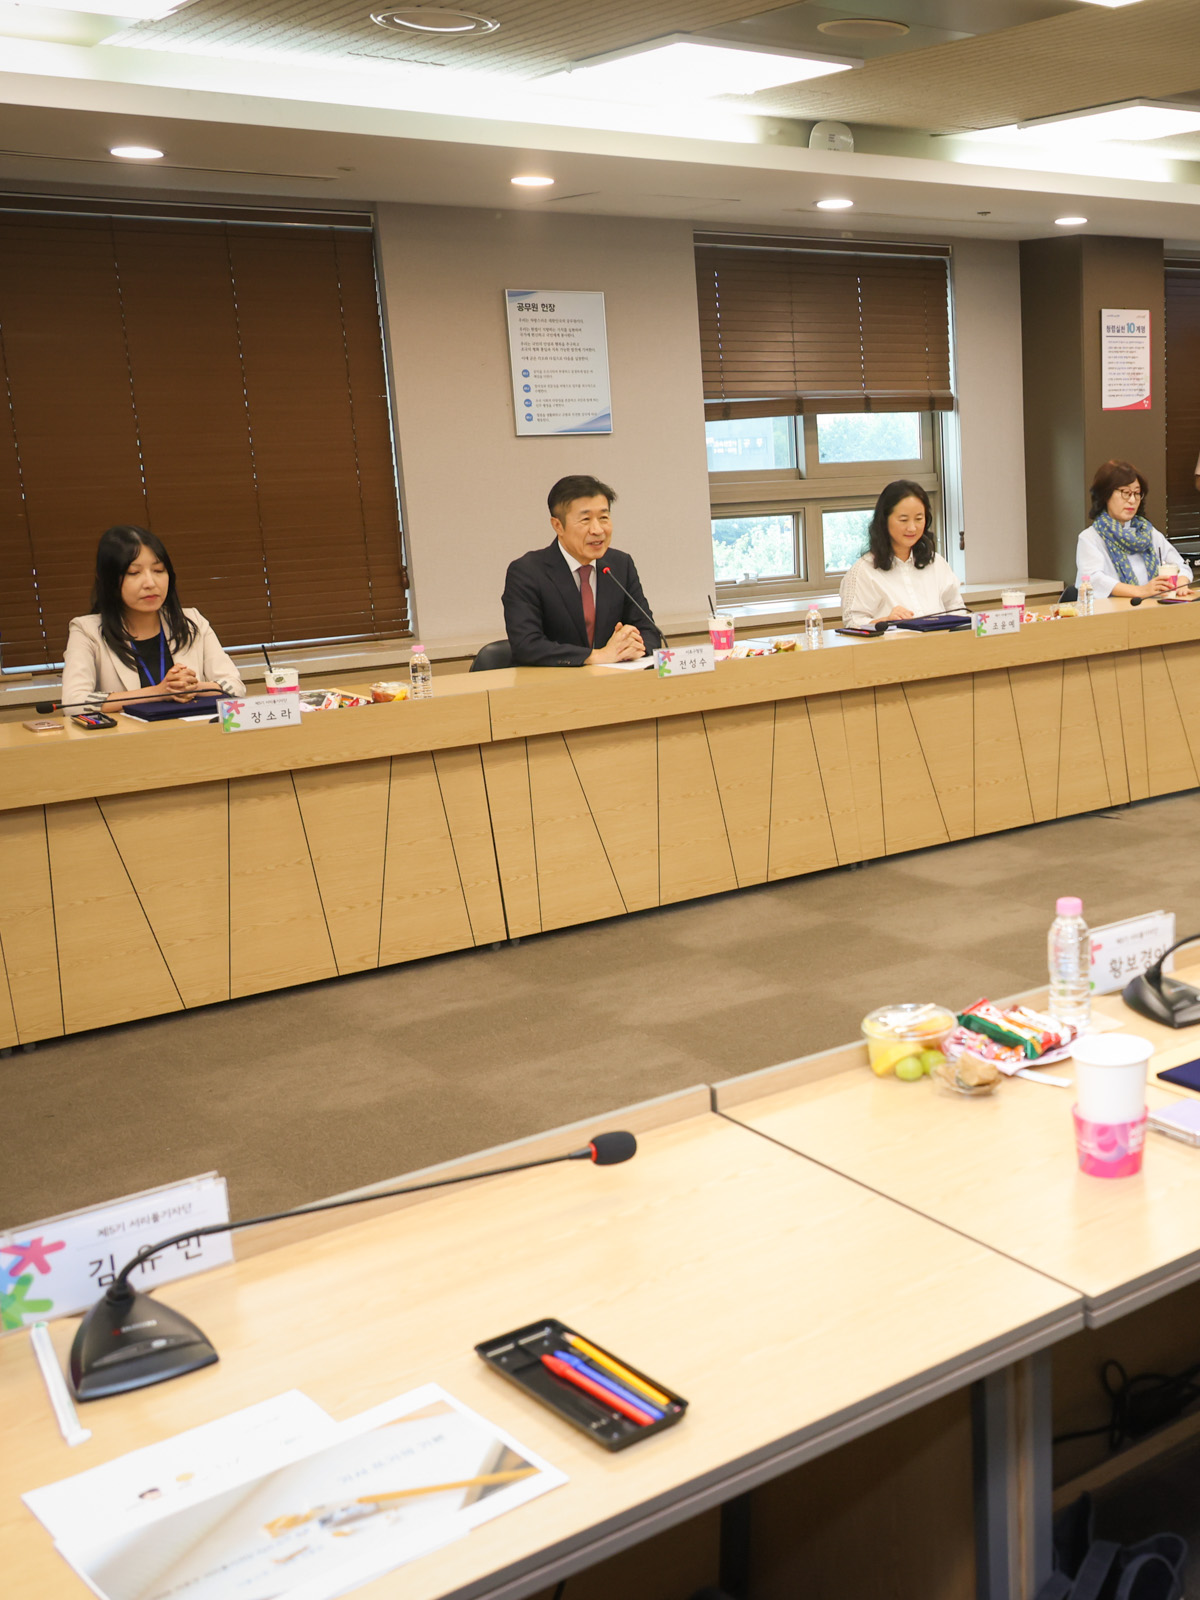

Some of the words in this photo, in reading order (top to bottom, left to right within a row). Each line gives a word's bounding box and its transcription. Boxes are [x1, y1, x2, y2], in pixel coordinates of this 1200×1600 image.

[516, 302, 539, 313] 공무원
[540, 303, 556, 313] 헌장
[97, 1220, 126, 1238] 제5기
[129, 1202, 193, 1229] 서리풀기자단
